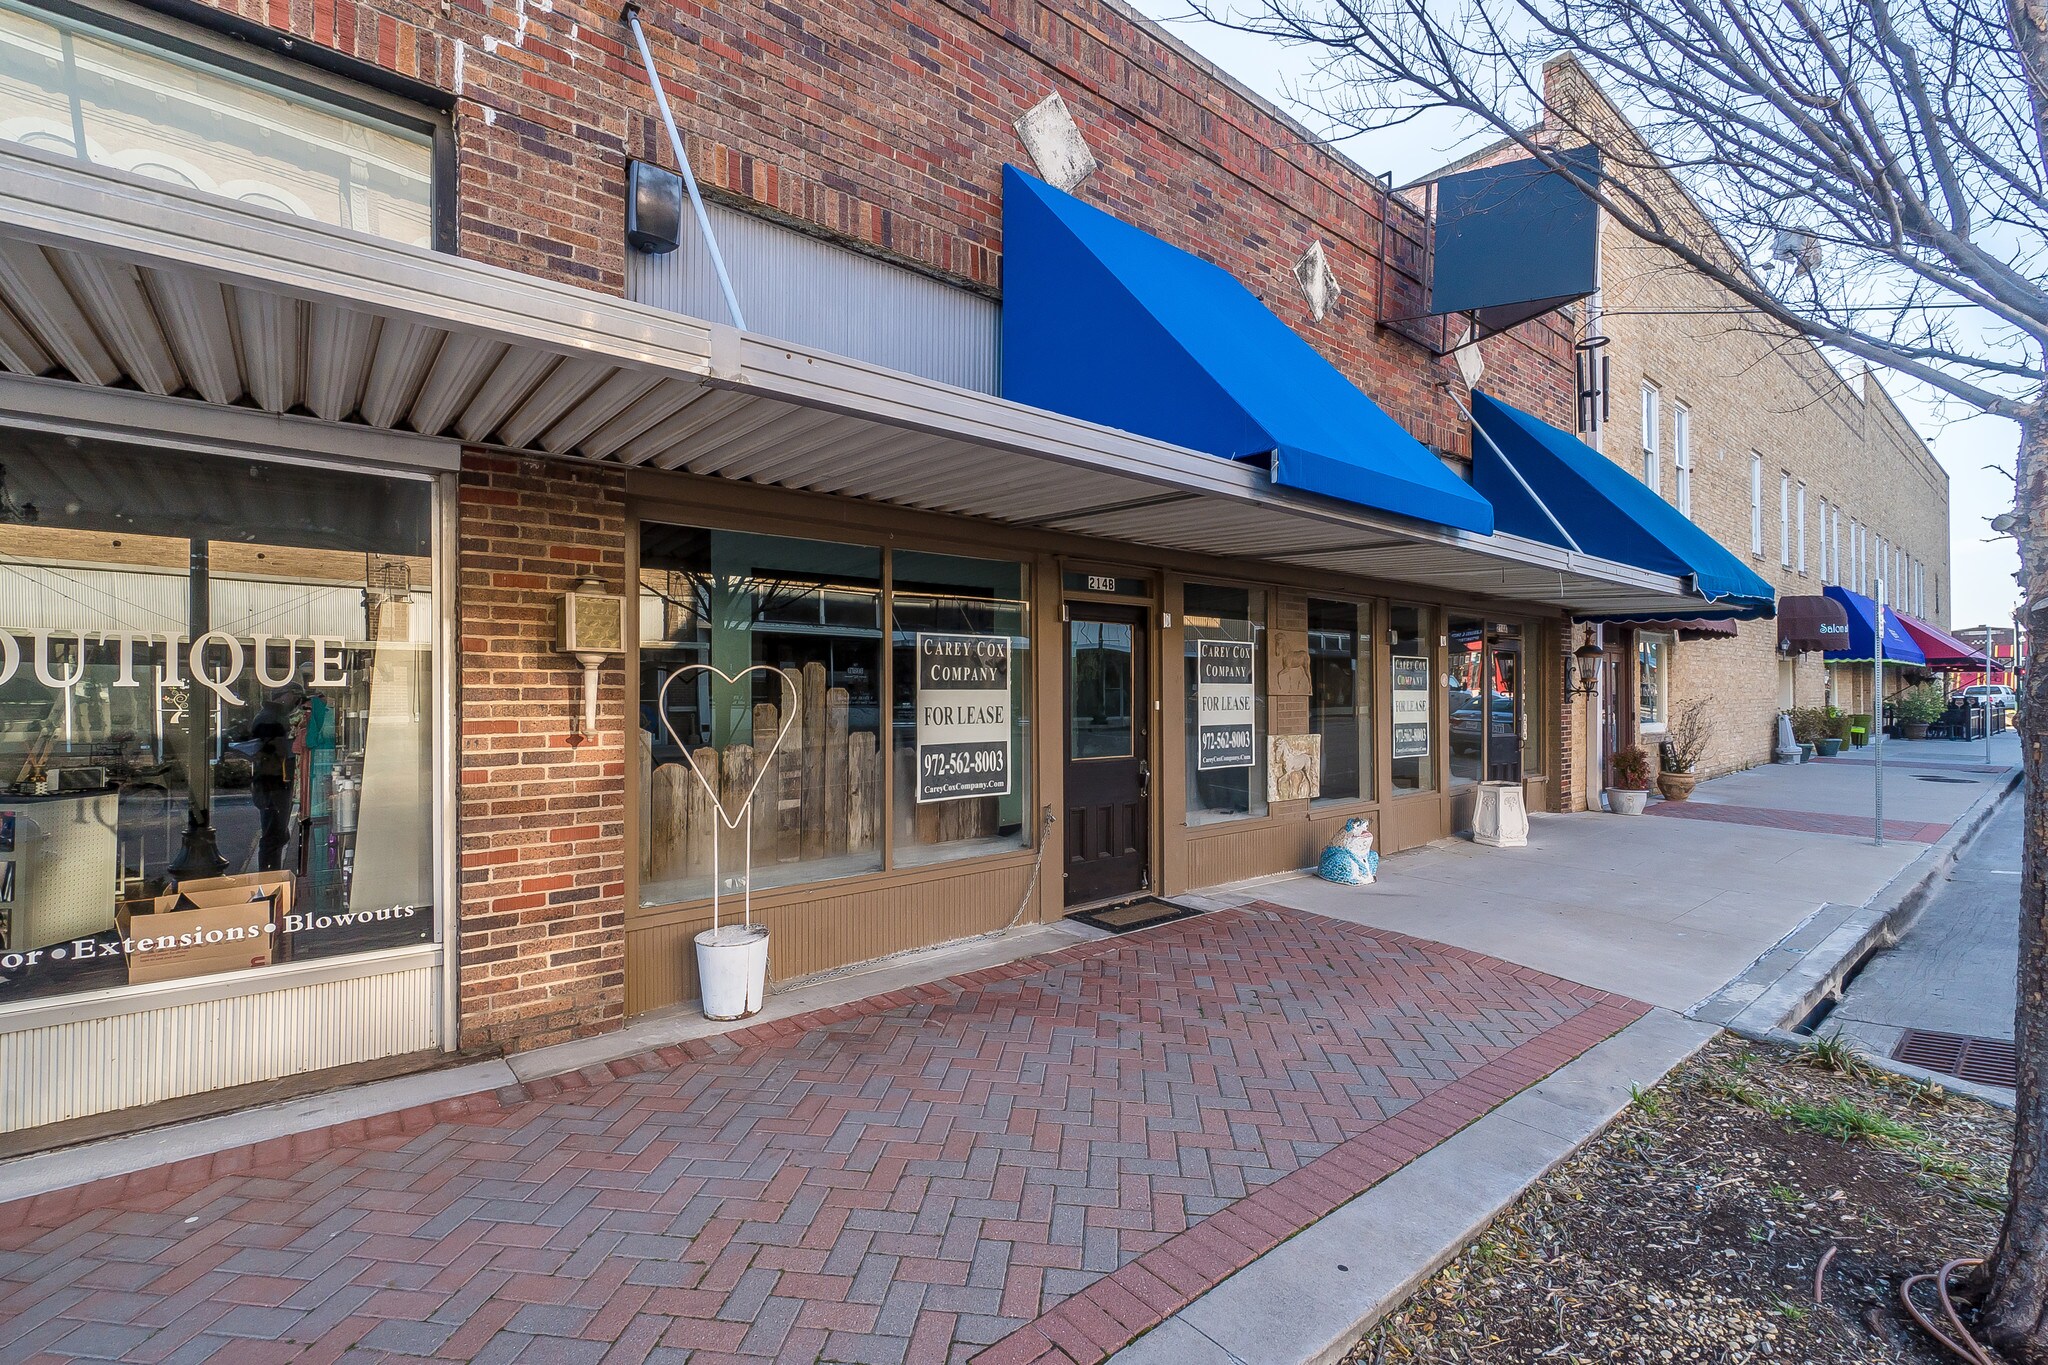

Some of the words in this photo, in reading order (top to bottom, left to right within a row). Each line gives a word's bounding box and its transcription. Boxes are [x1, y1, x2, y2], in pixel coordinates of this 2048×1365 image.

[1089, 577, 1114, 590] 214B
[1819, 623, 1844, 634] Salon
[923, 638, 971, 657] CAREY
[977, 640, 1005, 658] COX
[1201, 644, 1231, 658] CAREY
[1232, 645, 1251, 659] COX
[930, 664, 998, 682] COMPANY
[1205, 663, 1247, 678] COMPANY
[1202, 696, 1219, 711] FOR
[1221, 695, 1251, 711] LEASE
[1395, 701, 1405, 713] FOR
[1406, 700, 1427, 712] LEASE
[924, 706, 954, 726] FOR
[957, 705, 1004, 725] LEASE
[1202, 730, 1251, 750] 972-562-8003
[924, 750, 1004, 777] 972-562-8003
[924, 779, 1005, 795] CareyCoxCompany.Com
[71, 924, 260, 961] Extensions
[282, 902, 416, 934] Blowouts
